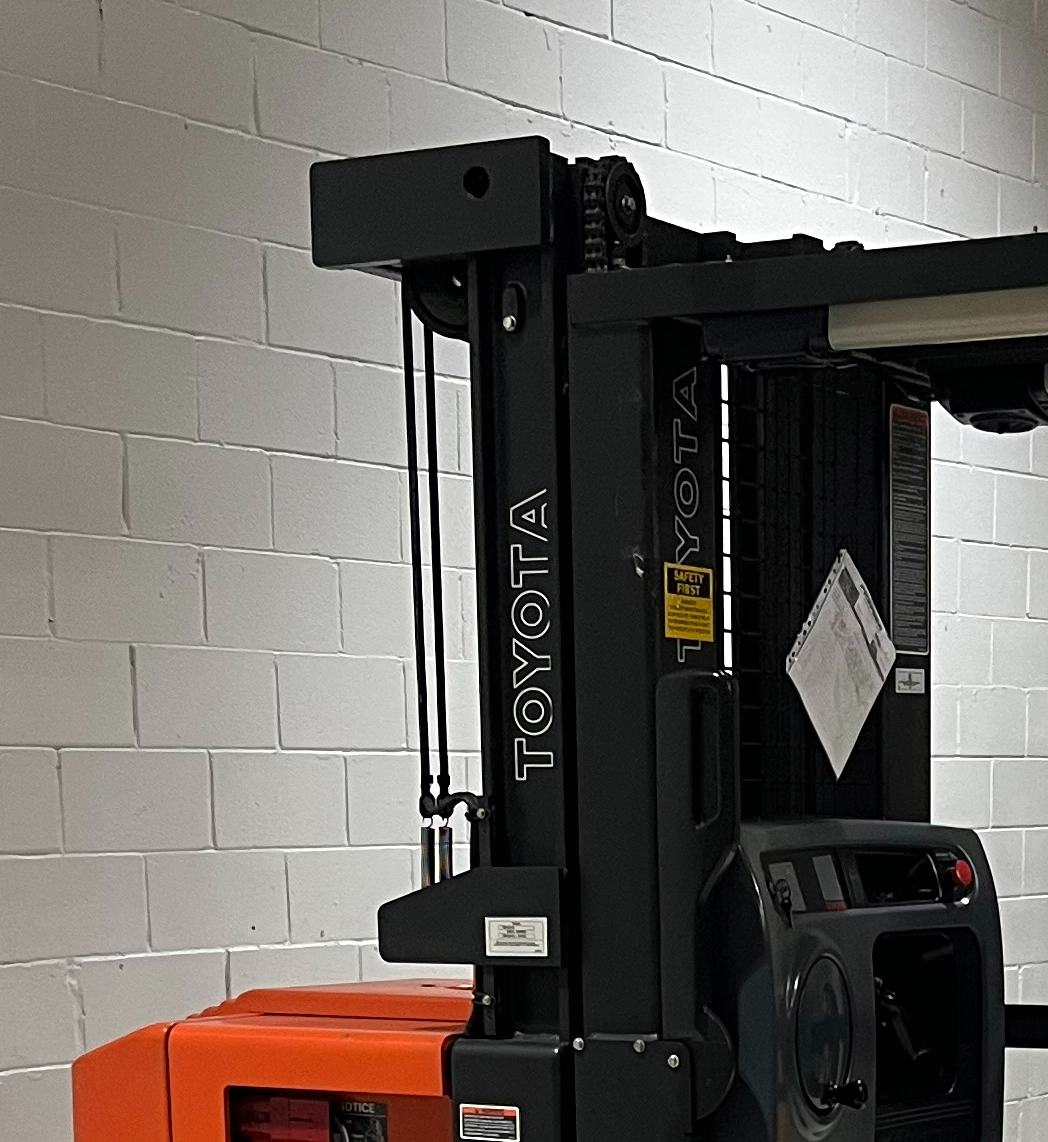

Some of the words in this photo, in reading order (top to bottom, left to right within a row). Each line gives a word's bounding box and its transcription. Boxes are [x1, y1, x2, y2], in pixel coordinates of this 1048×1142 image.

[673, 366, 702, 663] TYOTA
[674, 570, 705, 583] SAFETY
[676, 584, 701, 596] FIRST
[509, 488, 554, 781] TOYOTA
